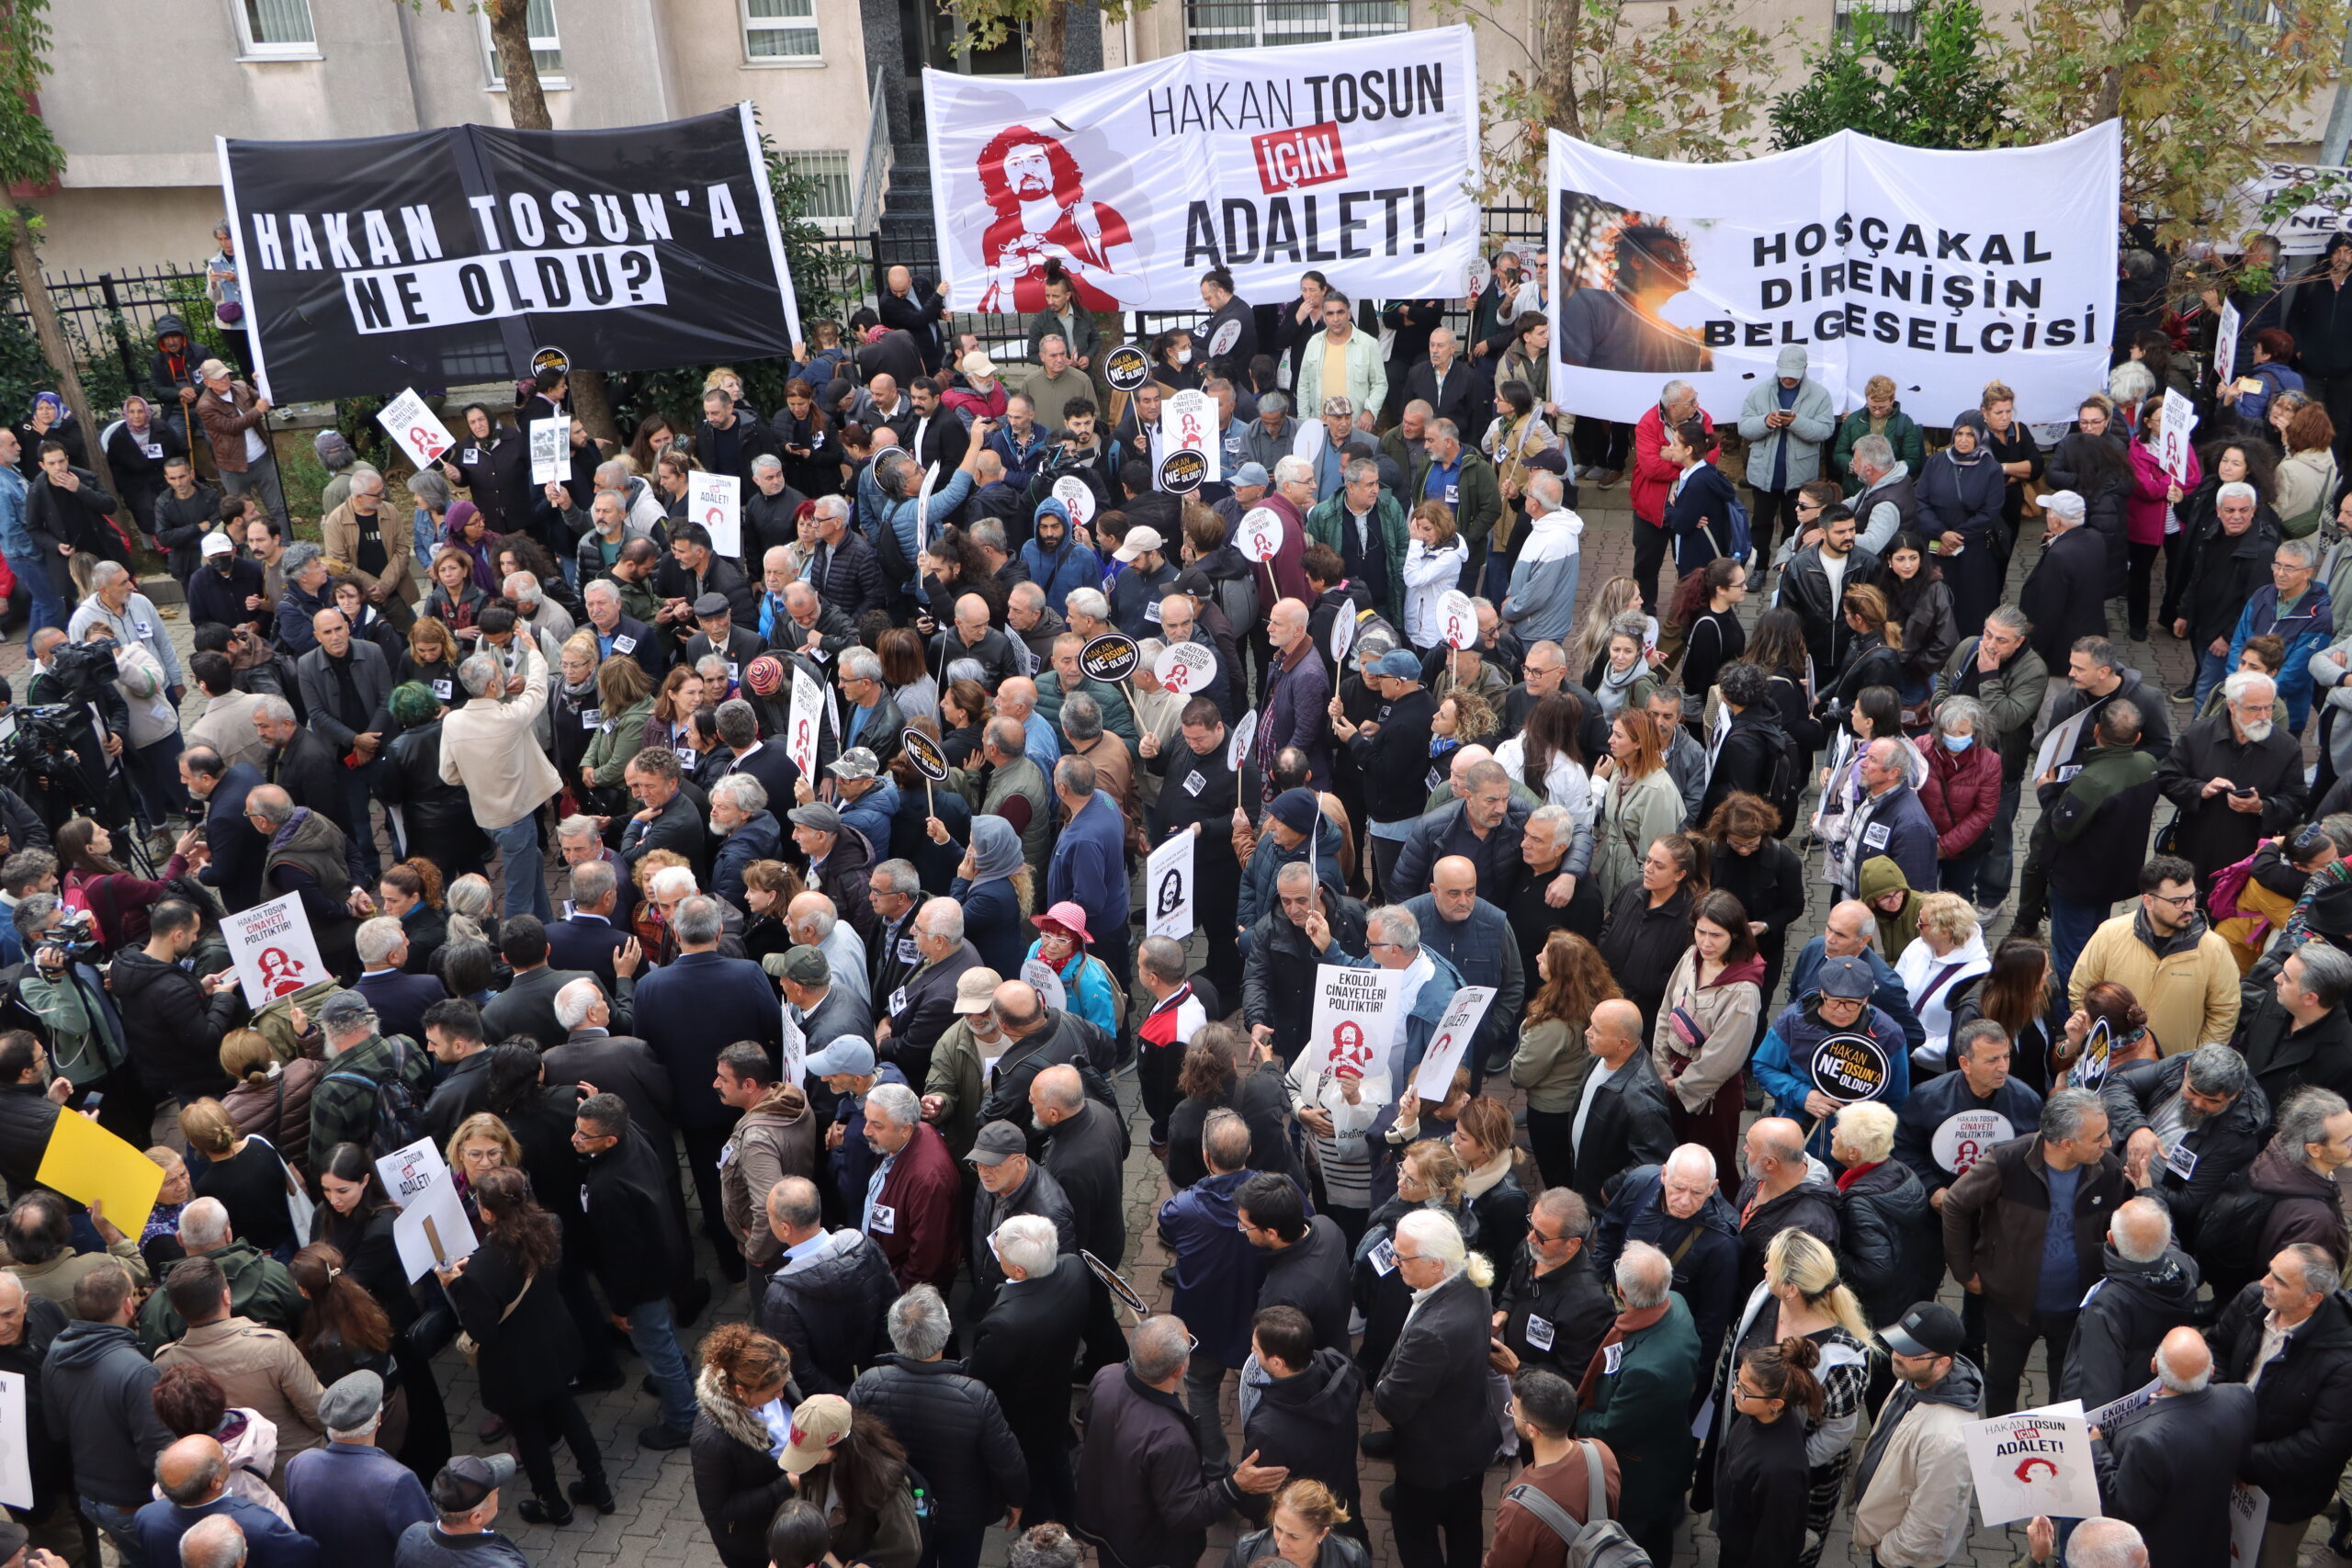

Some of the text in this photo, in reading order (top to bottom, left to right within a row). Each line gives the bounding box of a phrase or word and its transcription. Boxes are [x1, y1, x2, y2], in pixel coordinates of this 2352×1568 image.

[1148, 62, 1444, 137] HAKAN TOSUN
[1261, 131, 1337, 190] İÇİN
[252, 183, 744, 271] HAKAN TOSUN'A
[1184, 186, 1425, 267] ADALET!
[1753, 212, 2052, 268] HOŞÇAKAL
[352, 250, 652, 330] NE OLDU?
[1760, 258, 2041, 317] DİRENİŞİN
[1703, 301, 2095, 355] BELGESELCİSİ
[1109, 354, 1132, 367] HAKAN
[1109, 367, 1145, 383] NE OLDU?
[1166, 457, 1190, 470] HAKAN
[1164, 469, 1203, 485] NE OLDU?
[700, 491, 729, 505] ADALET!
[1085, 641, 1114, 660] HAKAN
[1101, 643, 1134, 662] TOSUN'A
[1174, 648, 1210, 666] CİNAYETLERİ
[1183, 643, 1210, 659] GAZETECİ
[1087, 651, 1135, 674] NE OLDU?
[907, 739, 922, 760] NE
[909, 732, 933, 755] HAKAN
[237, 902, 288, 928] HAKAN TOSUN
[245, 911, 285, 934] CİNAYETİ
[244, 919, 292, 946] POLİTİKTİR!
[1339, 973, 1377, 987] EKOLOJİ
[1326, 984, 1387, 1000] CİNAYETLERİ
[1329, 998, 1383, 1013] POLİTİKTİR!
[1828, 1042, 1869, 1066] HAKAN
[1817, 1053, 1873, 1094] NE OLDU?
[1839, 1058, 1882, 1084] TOSUN'A
[1960, 1121, 1994, 1131] CİNAYETİ
[1979, 1114, 1999, 1122] TOSUN
[1954, 1130, 1996, 1139] POLİTİKTİR!
[404, 1150, 425, 1166] TOSUN
[2102, 1393, 2142, 1421] EKOLOJİ
[1984, 1418, 2066, 1436] HAKAN TOSUN
[1996, 1439, 2064, 1457] ADALET!
